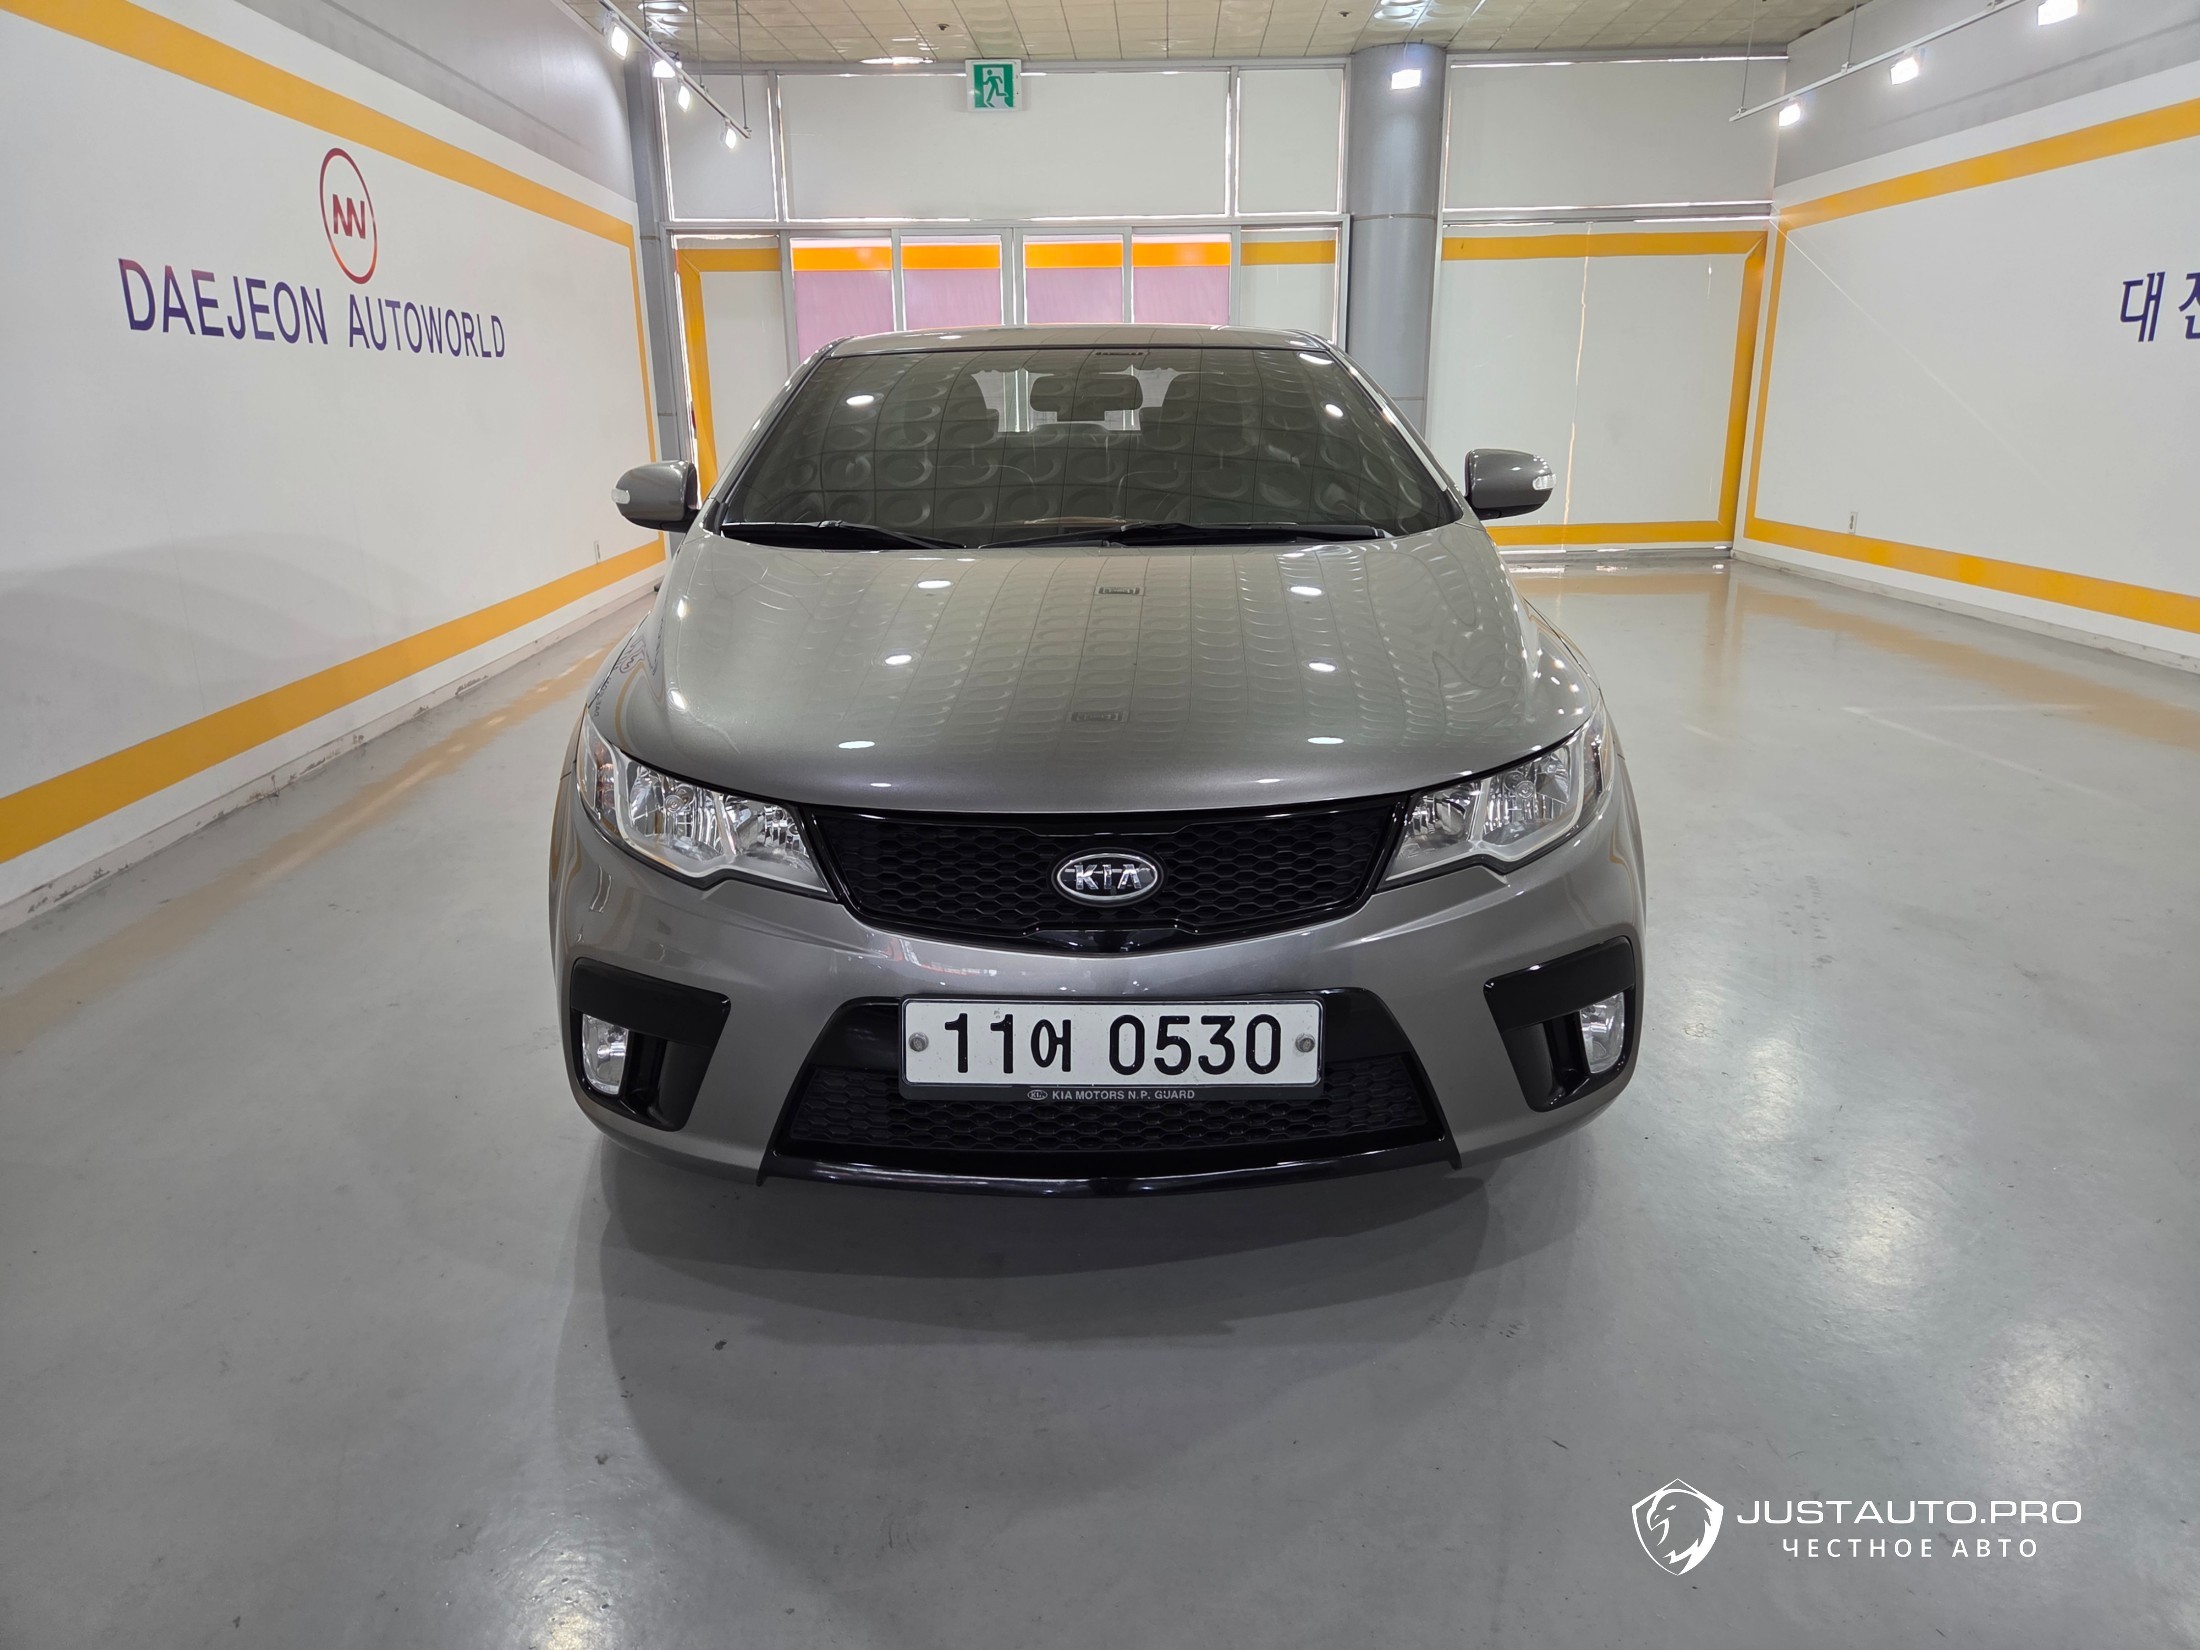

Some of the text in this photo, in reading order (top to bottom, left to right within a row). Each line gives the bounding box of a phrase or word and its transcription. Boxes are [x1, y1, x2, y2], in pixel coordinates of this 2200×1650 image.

[118, 257, 506, 358] DAEJEON AUTOWORLD
[1073, 863, 1143, 890] KIA
[944, 1012, 1282, 1077] 11어 0530
[1052, 1090, 1073, 1100] KIA
[1075, 1090, 1125, 1100] MOTORS
[1154, 1090, 1195, 1099] GUARD
